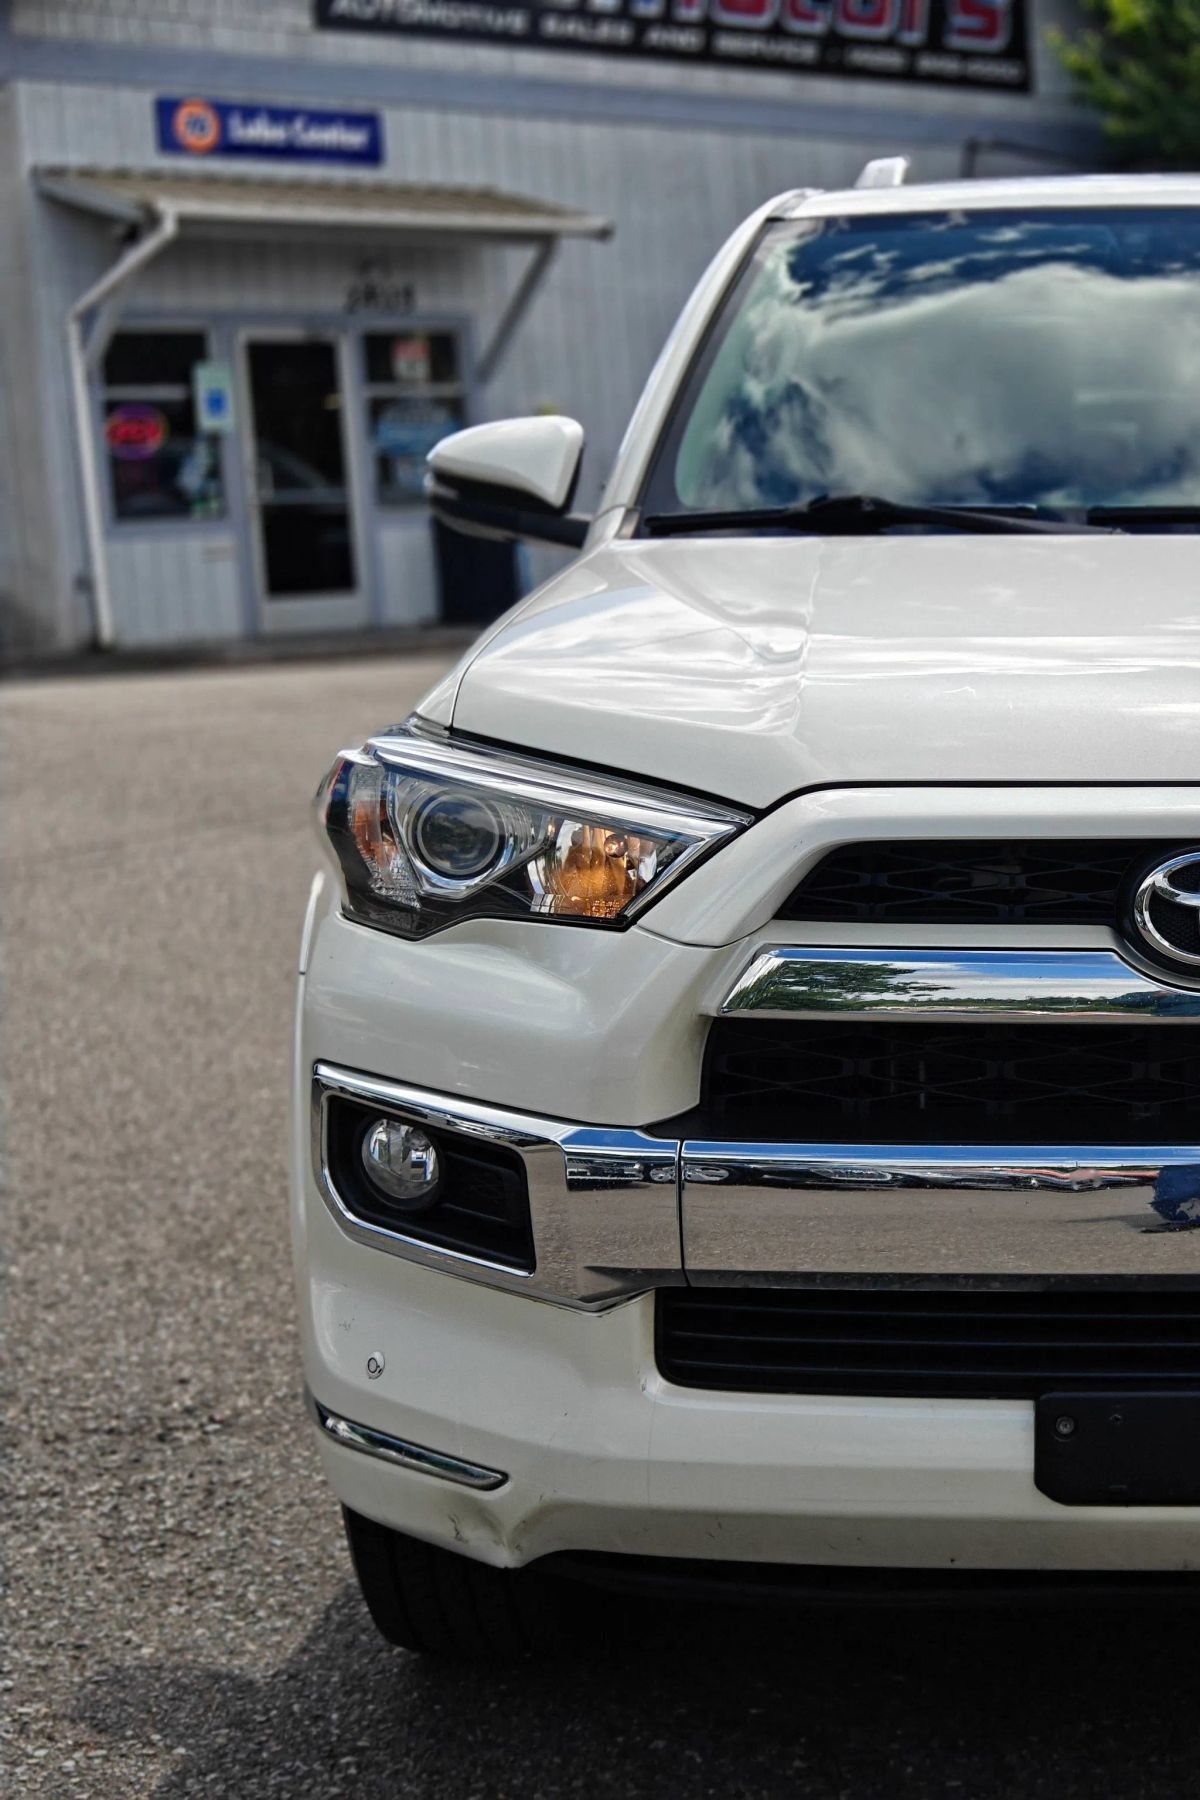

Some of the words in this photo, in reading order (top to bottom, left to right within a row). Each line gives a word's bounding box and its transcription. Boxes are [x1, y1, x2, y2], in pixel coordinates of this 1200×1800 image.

[543, 17, 632, 44] SALES
[645, 28, 705, 52] AND
[713, 35, 818, 65] SERVICE
